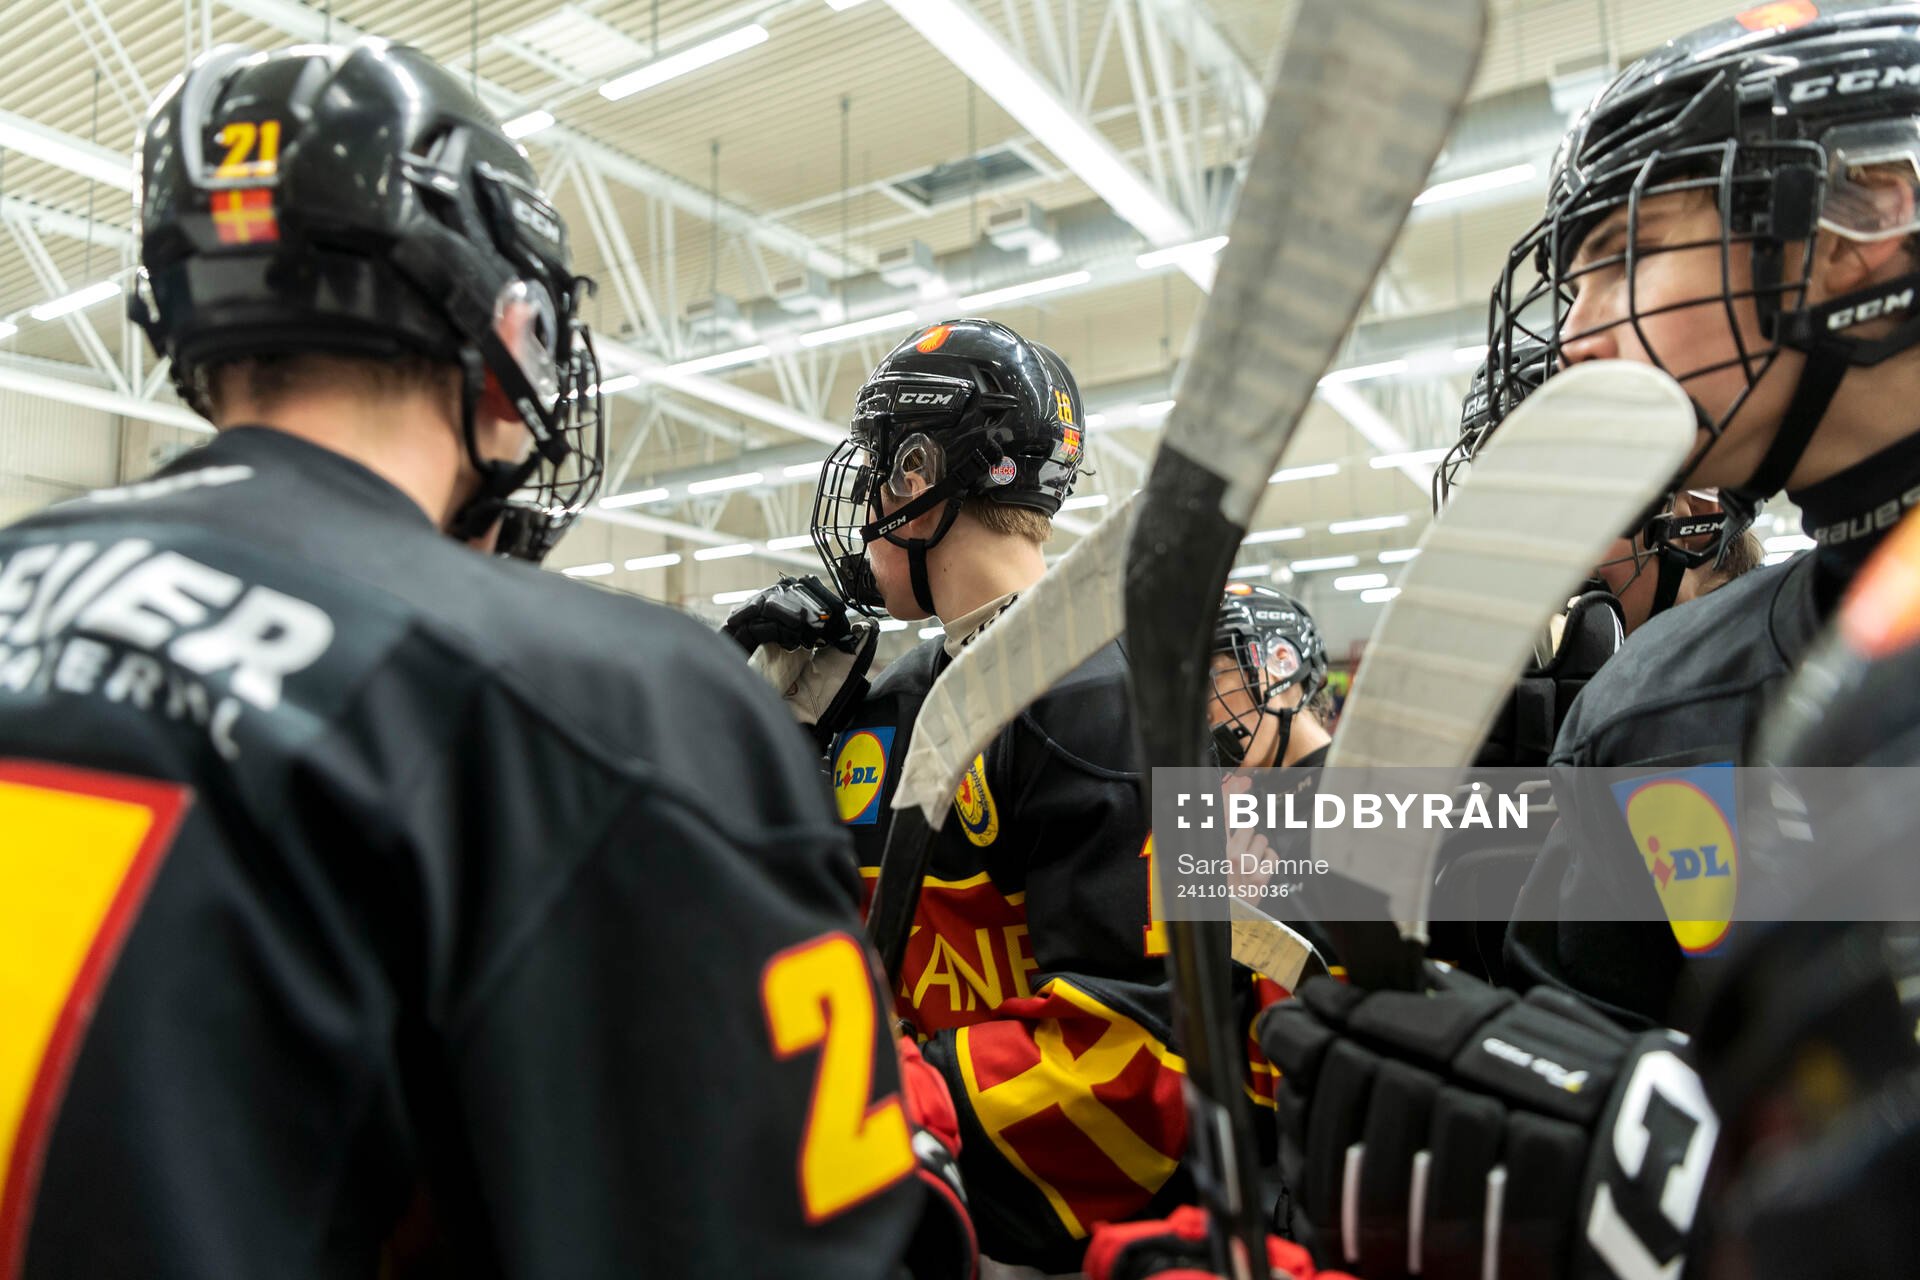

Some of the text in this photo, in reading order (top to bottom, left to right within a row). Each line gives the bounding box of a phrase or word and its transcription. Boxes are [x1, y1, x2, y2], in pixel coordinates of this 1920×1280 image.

[1789, 64, 1920, 102] CCM
[215, 120, 281, 177] 21
[1827, 288, 1914, 331] CCM
[899, 392, 954, 405] CCM
[878, 514, 907, 535] CCM
[1256, 611, 1296, 621] CCM
[761, 931, 917, 1226] 2
